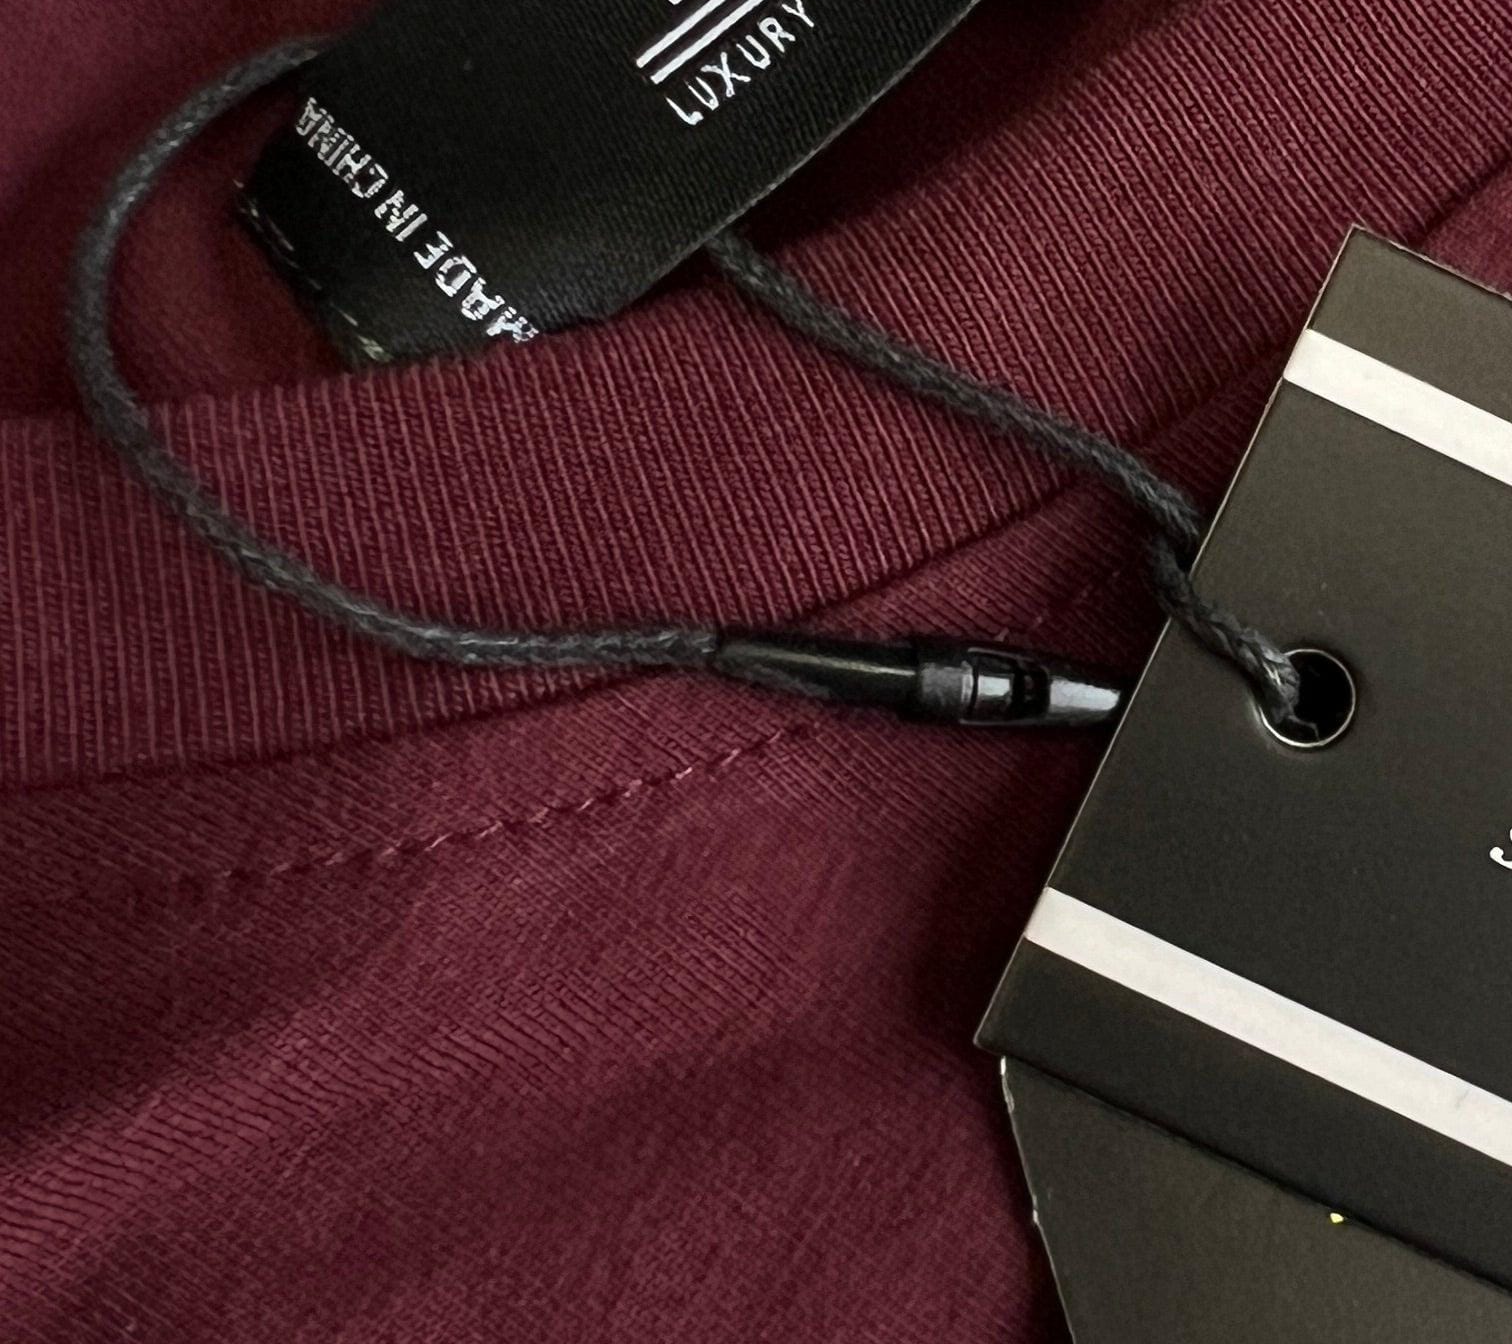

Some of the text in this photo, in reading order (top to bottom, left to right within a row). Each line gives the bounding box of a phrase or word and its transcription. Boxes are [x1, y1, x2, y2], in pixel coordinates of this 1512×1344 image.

[295, 96, 540, 344] MADE IN CHINA
